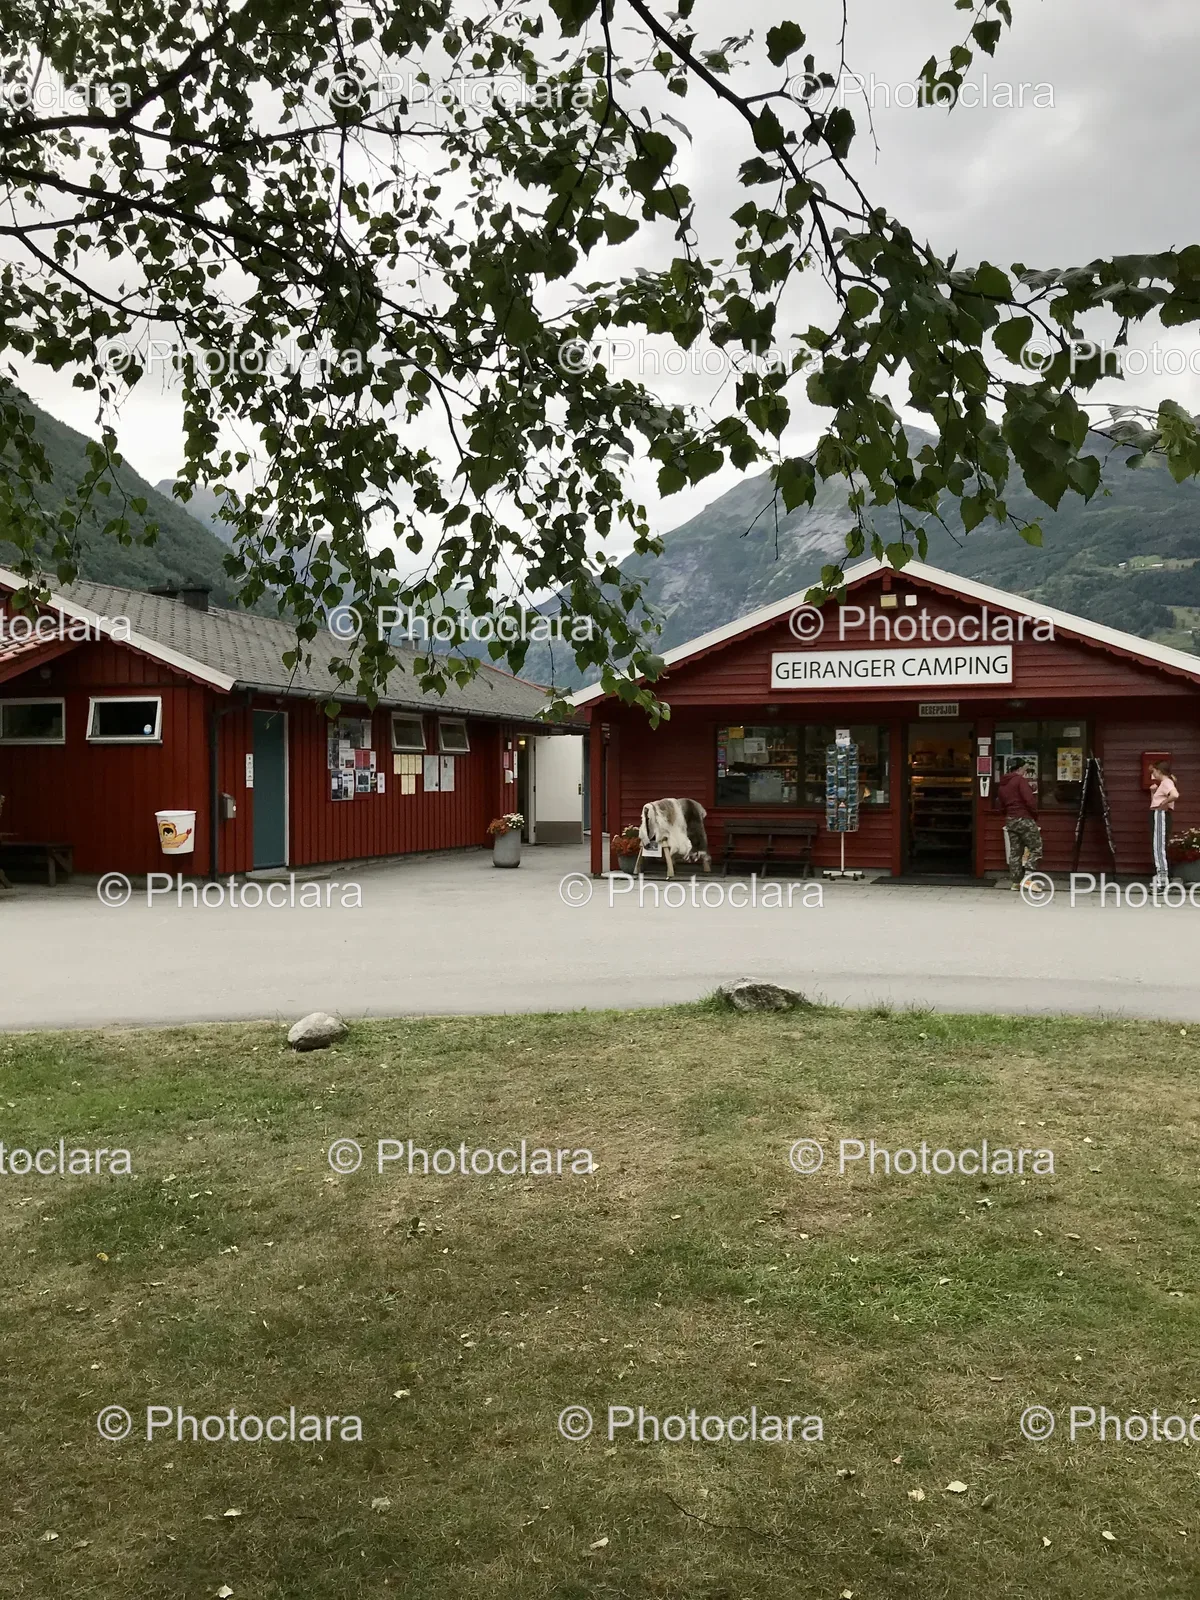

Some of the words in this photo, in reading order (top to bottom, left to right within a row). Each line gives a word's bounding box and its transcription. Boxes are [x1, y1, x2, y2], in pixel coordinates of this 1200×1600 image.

[775, 659, 896, 680] GEIRANGER
[902, 655, 1009, 677] CAMPING
[921, 705, 957, 715] RESEPSJON
